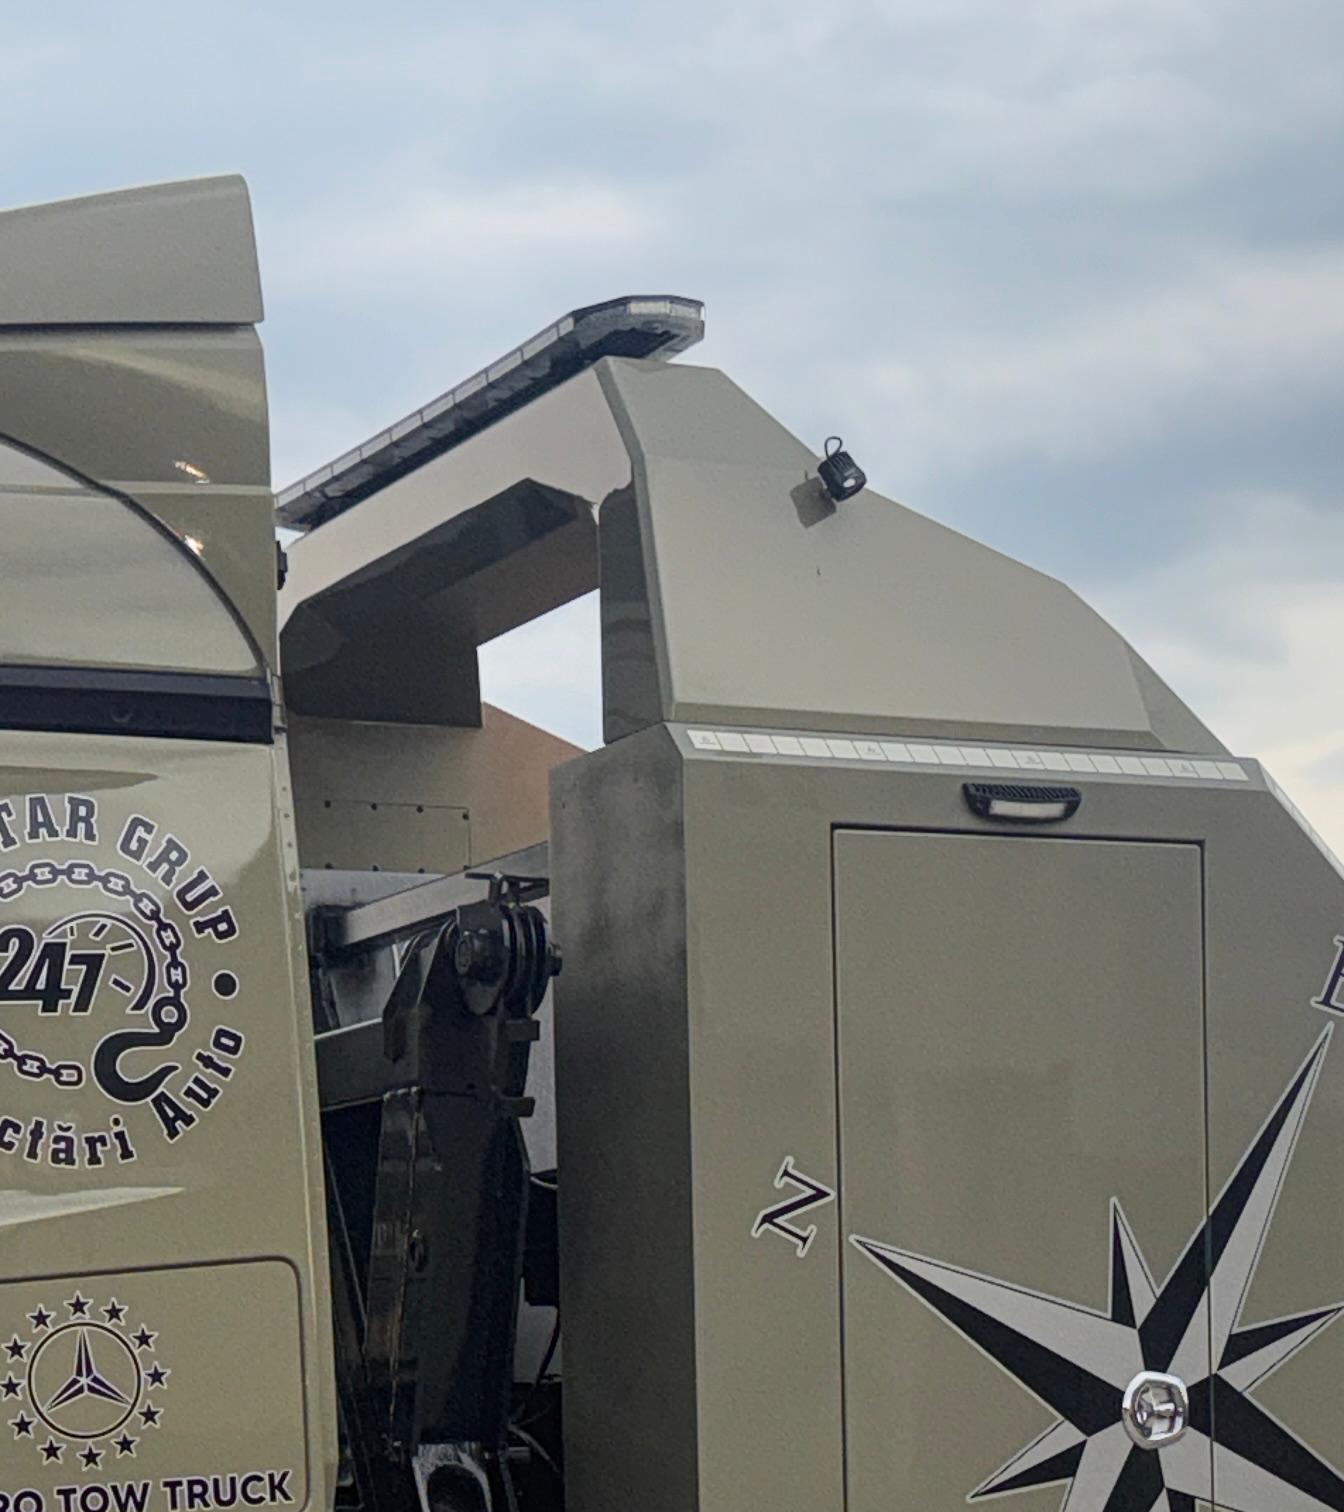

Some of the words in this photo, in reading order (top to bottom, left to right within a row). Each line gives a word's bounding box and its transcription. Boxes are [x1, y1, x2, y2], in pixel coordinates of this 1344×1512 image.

[117, 815, 238, 943] GRUP
[150, 1026, 243, 1141] Auto
[161, 1470, 293, 1512] TRUCK
